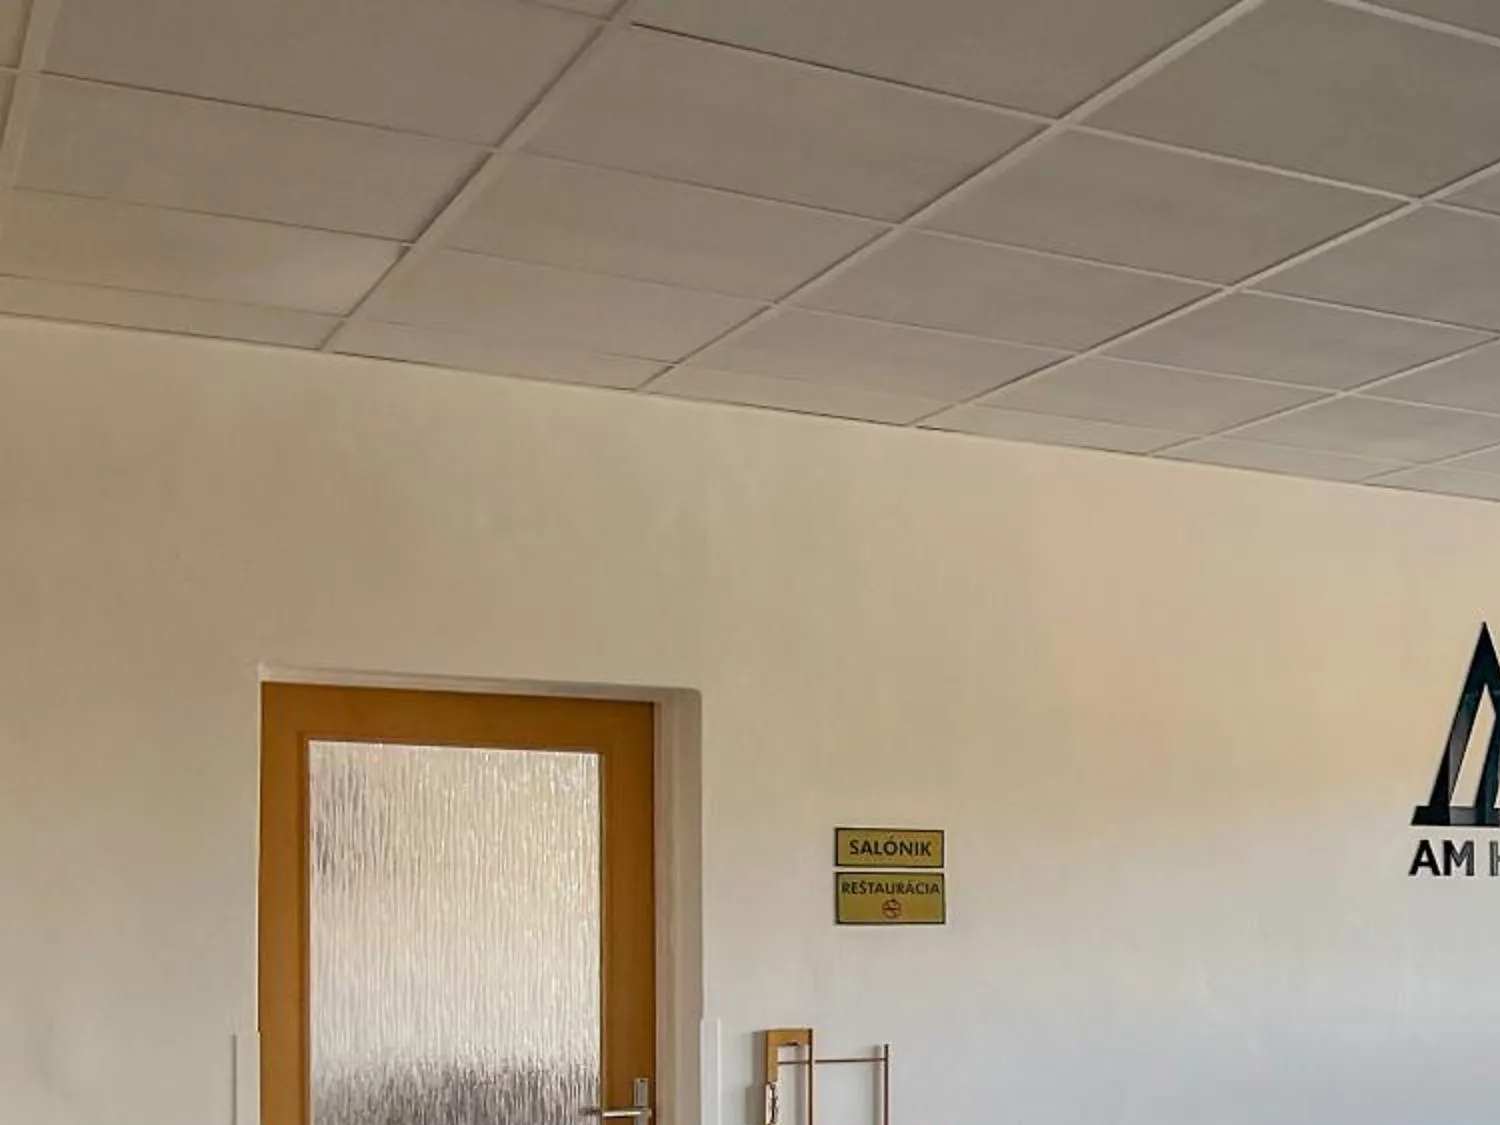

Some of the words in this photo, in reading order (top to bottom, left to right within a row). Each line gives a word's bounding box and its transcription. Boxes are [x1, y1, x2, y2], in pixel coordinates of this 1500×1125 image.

[849, 834, 932, 857] SALÓNIK
[1408, 839, 1475, 877] AM
[841, 879, 940, 895] REŠTAURÁCIA
